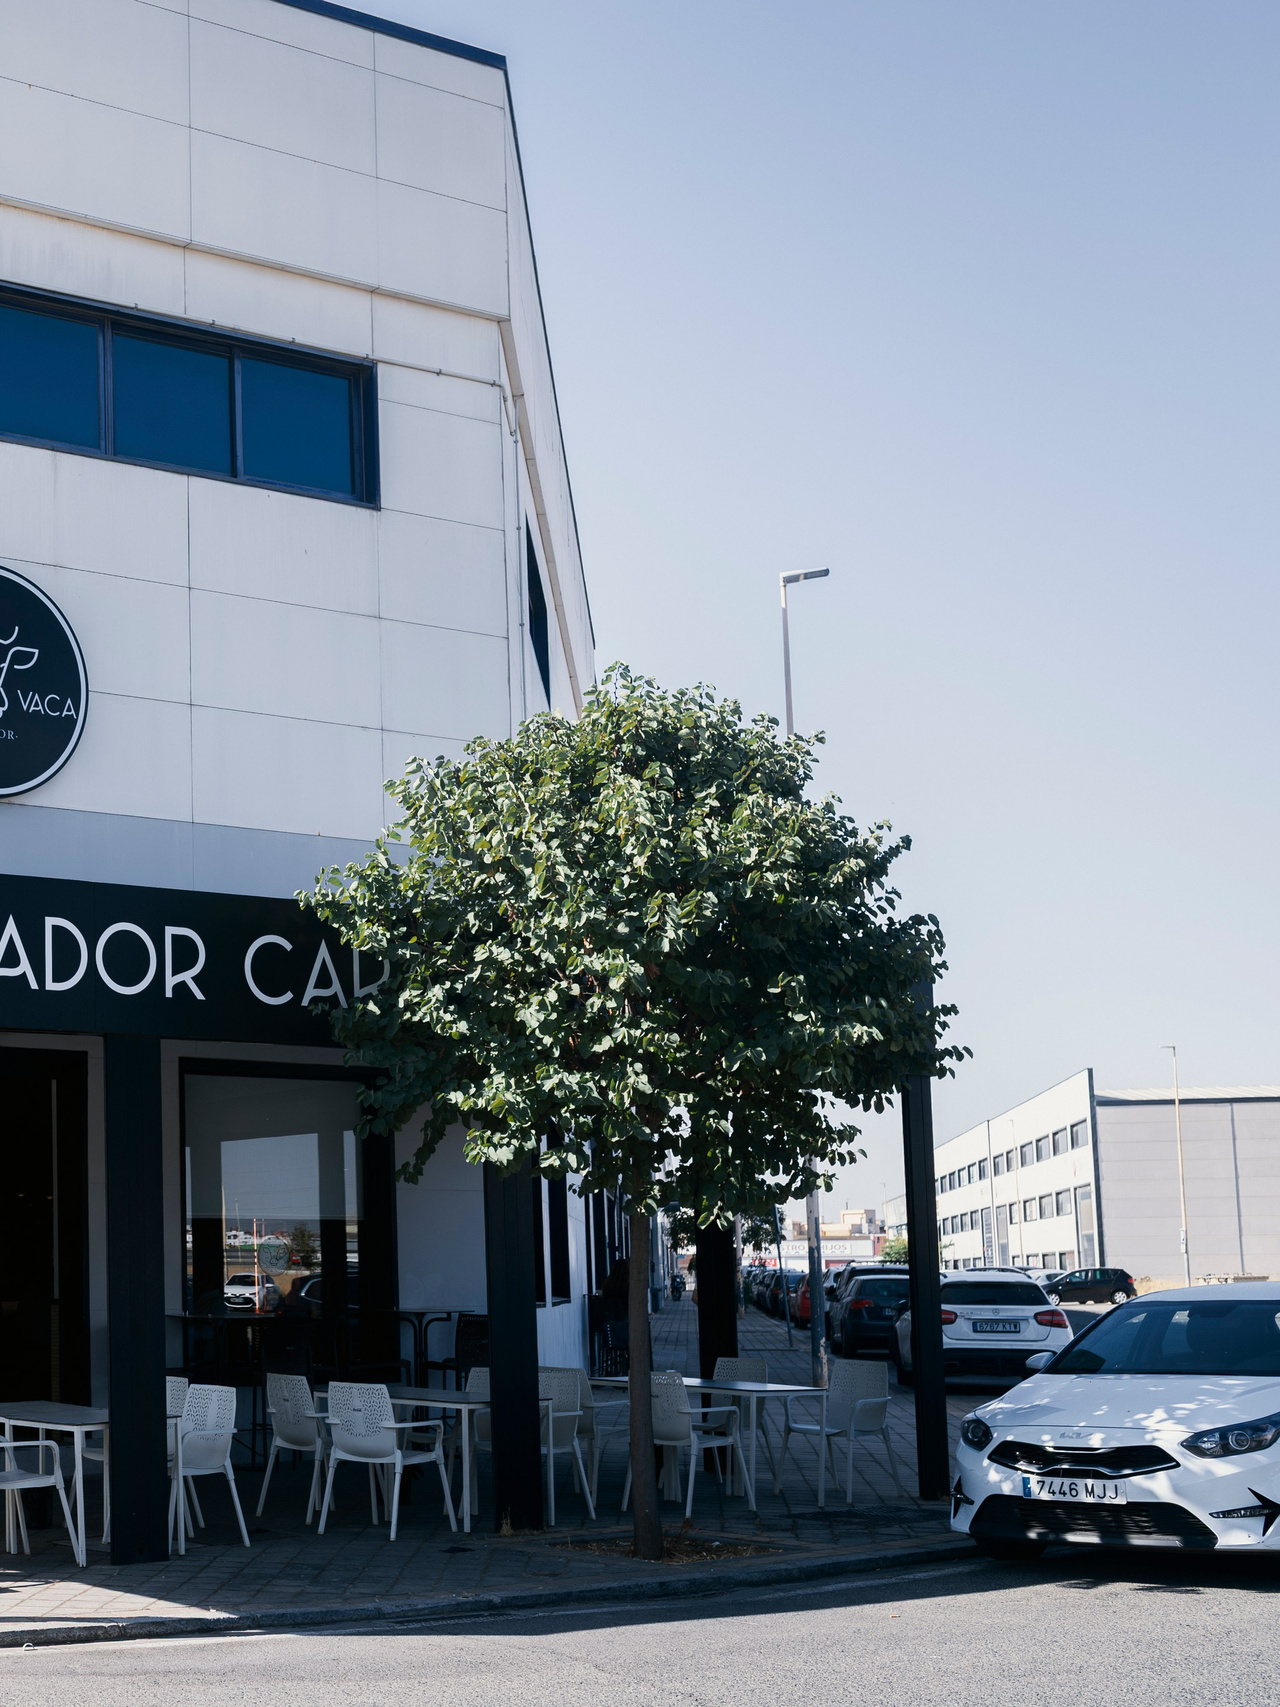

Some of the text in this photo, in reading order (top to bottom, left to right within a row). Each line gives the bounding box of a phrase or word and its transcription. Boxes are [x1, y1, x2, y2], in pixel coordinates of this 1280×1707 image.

[17, 689, 78, 719] VACA
[1036, 1480, 1119, 1500] 7446 MJJ
